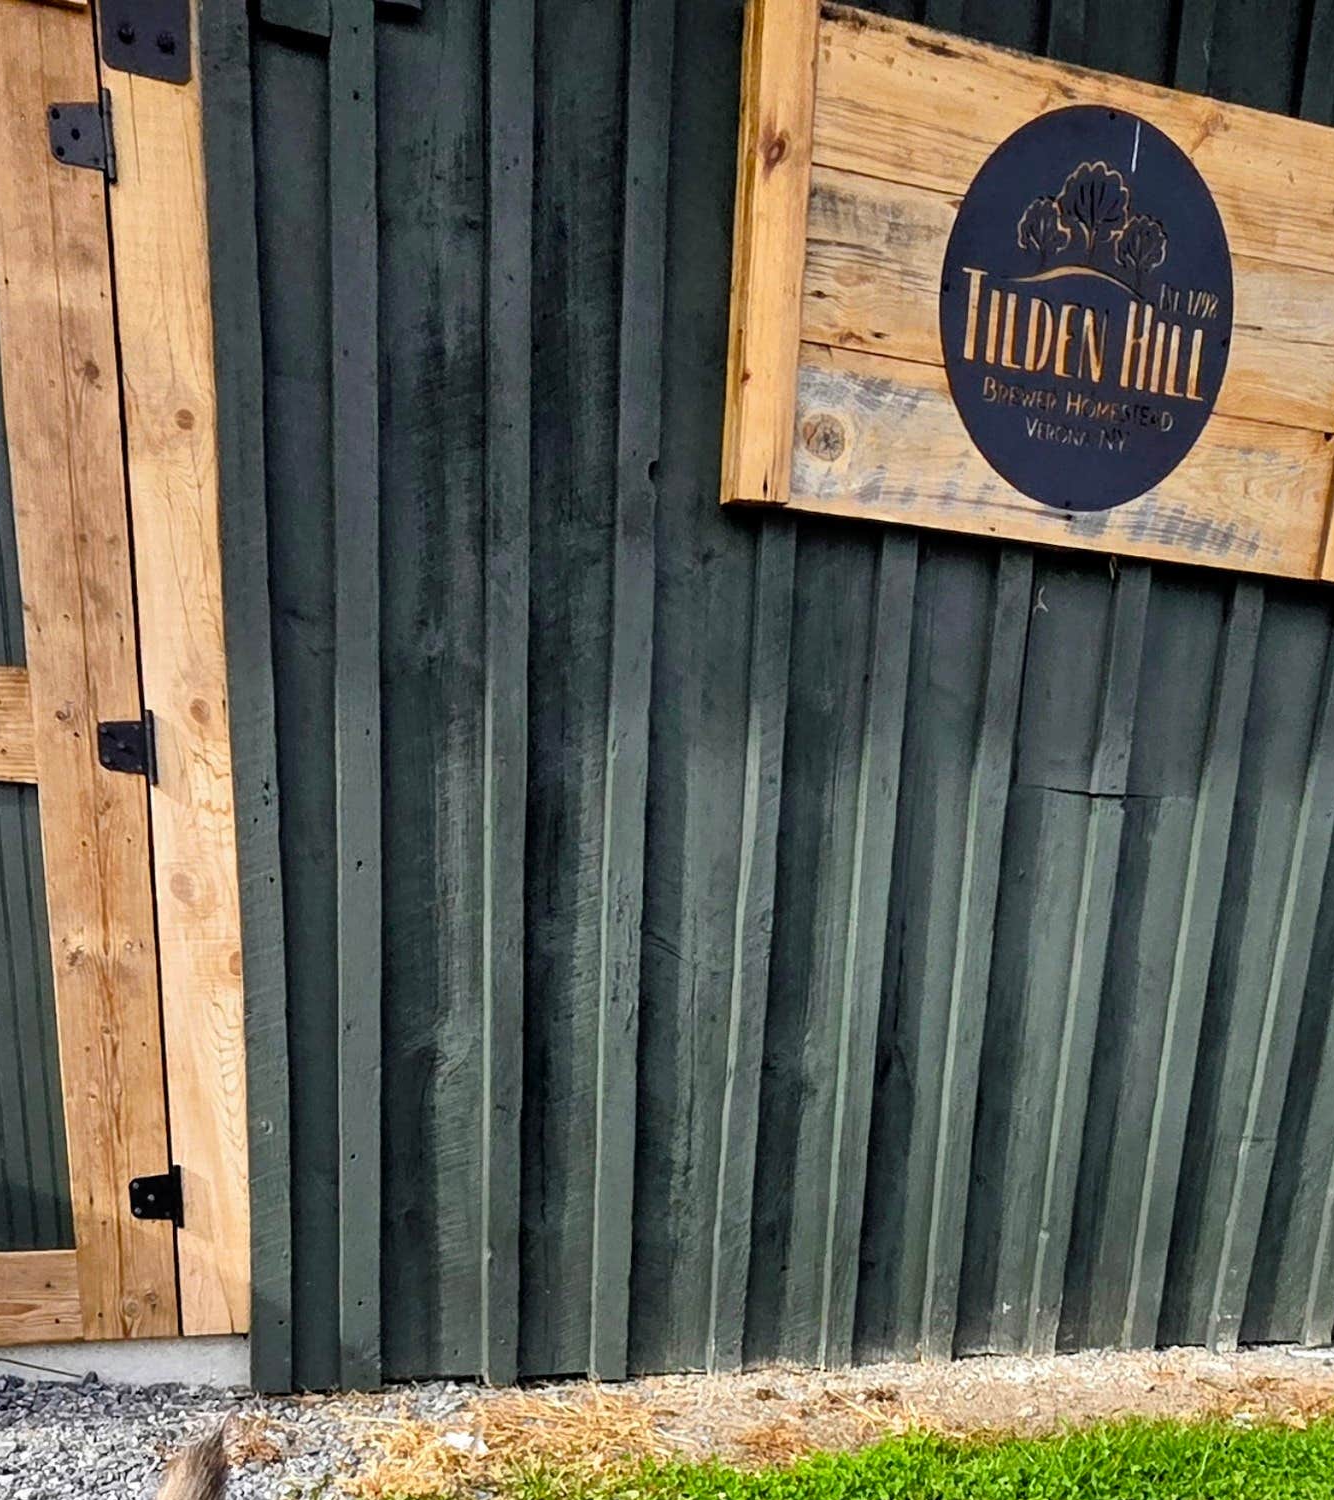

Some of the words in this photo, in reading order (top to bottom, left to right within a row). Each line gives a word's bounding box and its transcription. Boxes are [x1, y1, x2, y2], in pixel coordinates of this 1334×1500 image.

[962, 266, 1110, 384] TILDEN
[1119, 300, 1205, 402] HILL
[982, 376, 1057, 412] BREWER
[1025, 416, 1094, 448] VERON
[1099, 428, 1131, 454] NY
